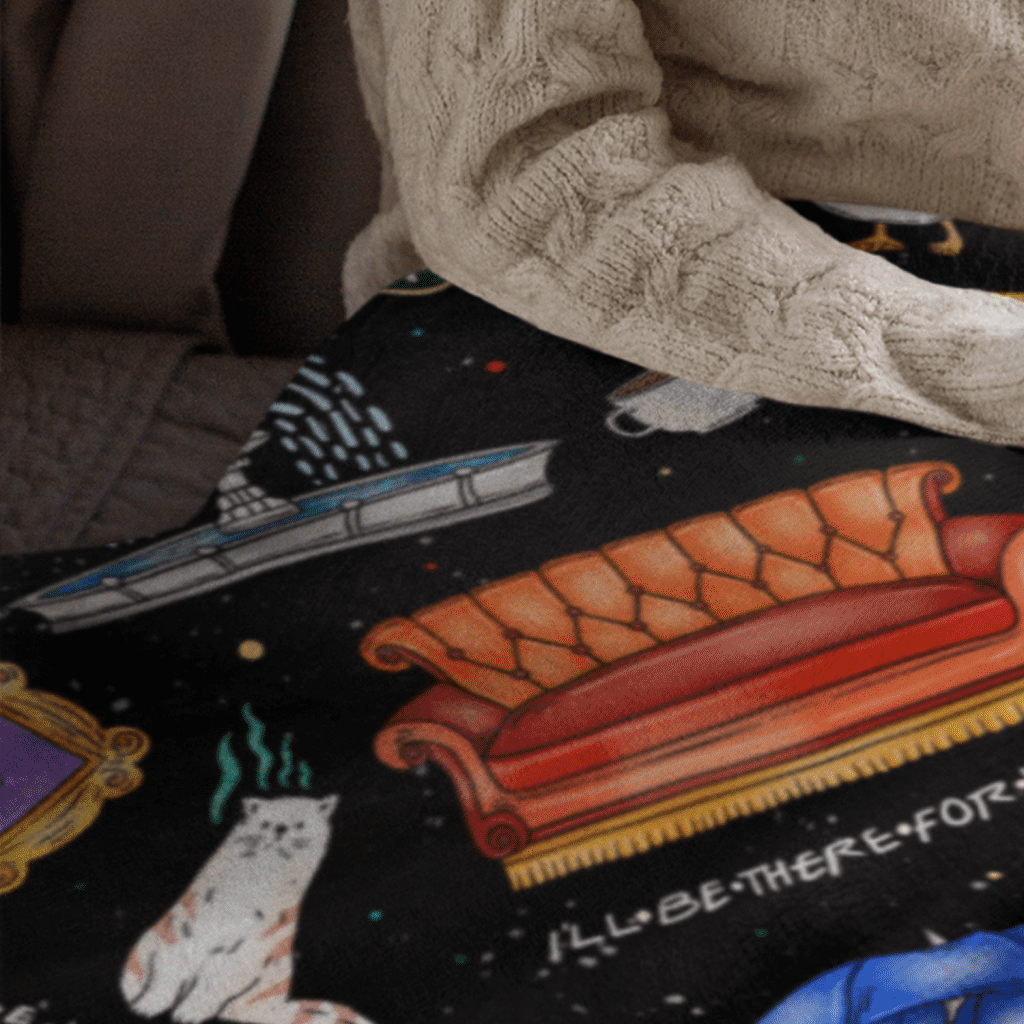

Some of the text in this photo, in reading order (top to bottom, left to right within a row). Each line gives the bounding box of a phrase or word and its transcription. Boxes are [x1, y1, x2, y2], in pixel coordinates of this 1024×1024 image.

[658, 881, 729, 925] BE
[743, 826, 899, 894] THERE
[913, 780, 1013, 842] FOR
